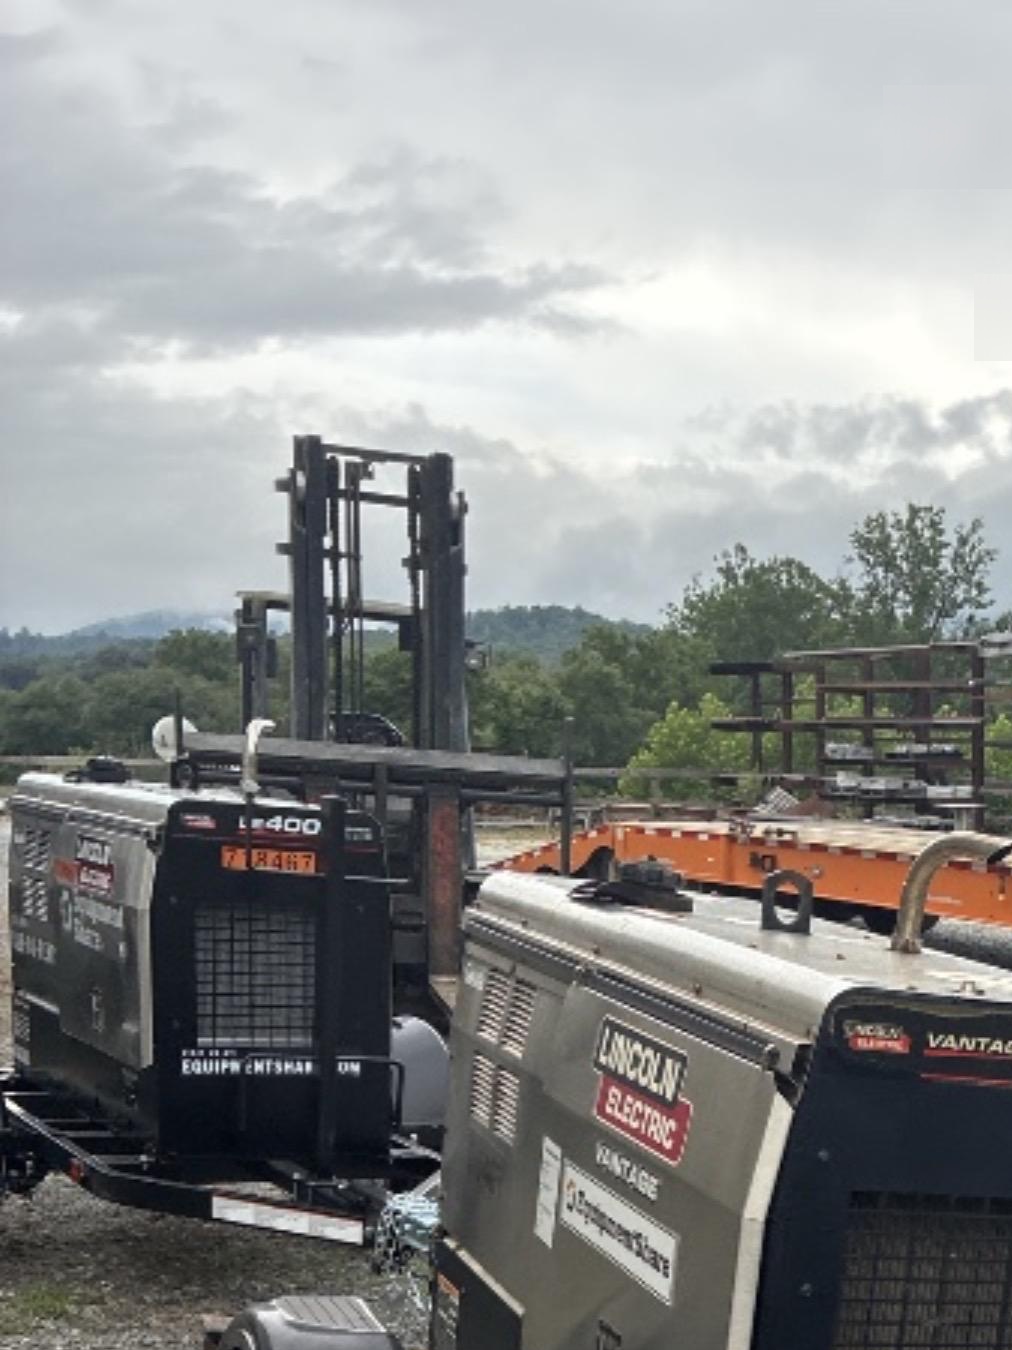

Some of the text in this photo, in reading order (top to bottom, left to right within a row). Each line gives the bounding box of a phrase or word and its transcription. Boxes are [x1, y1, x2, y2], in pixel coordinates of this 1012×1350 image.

[599, 1025, 682, 1102] LINCOLN
[605, 1086, 677, 1150] ELECTRIC
[595, 1142, 660, 1201] VANTAGE
